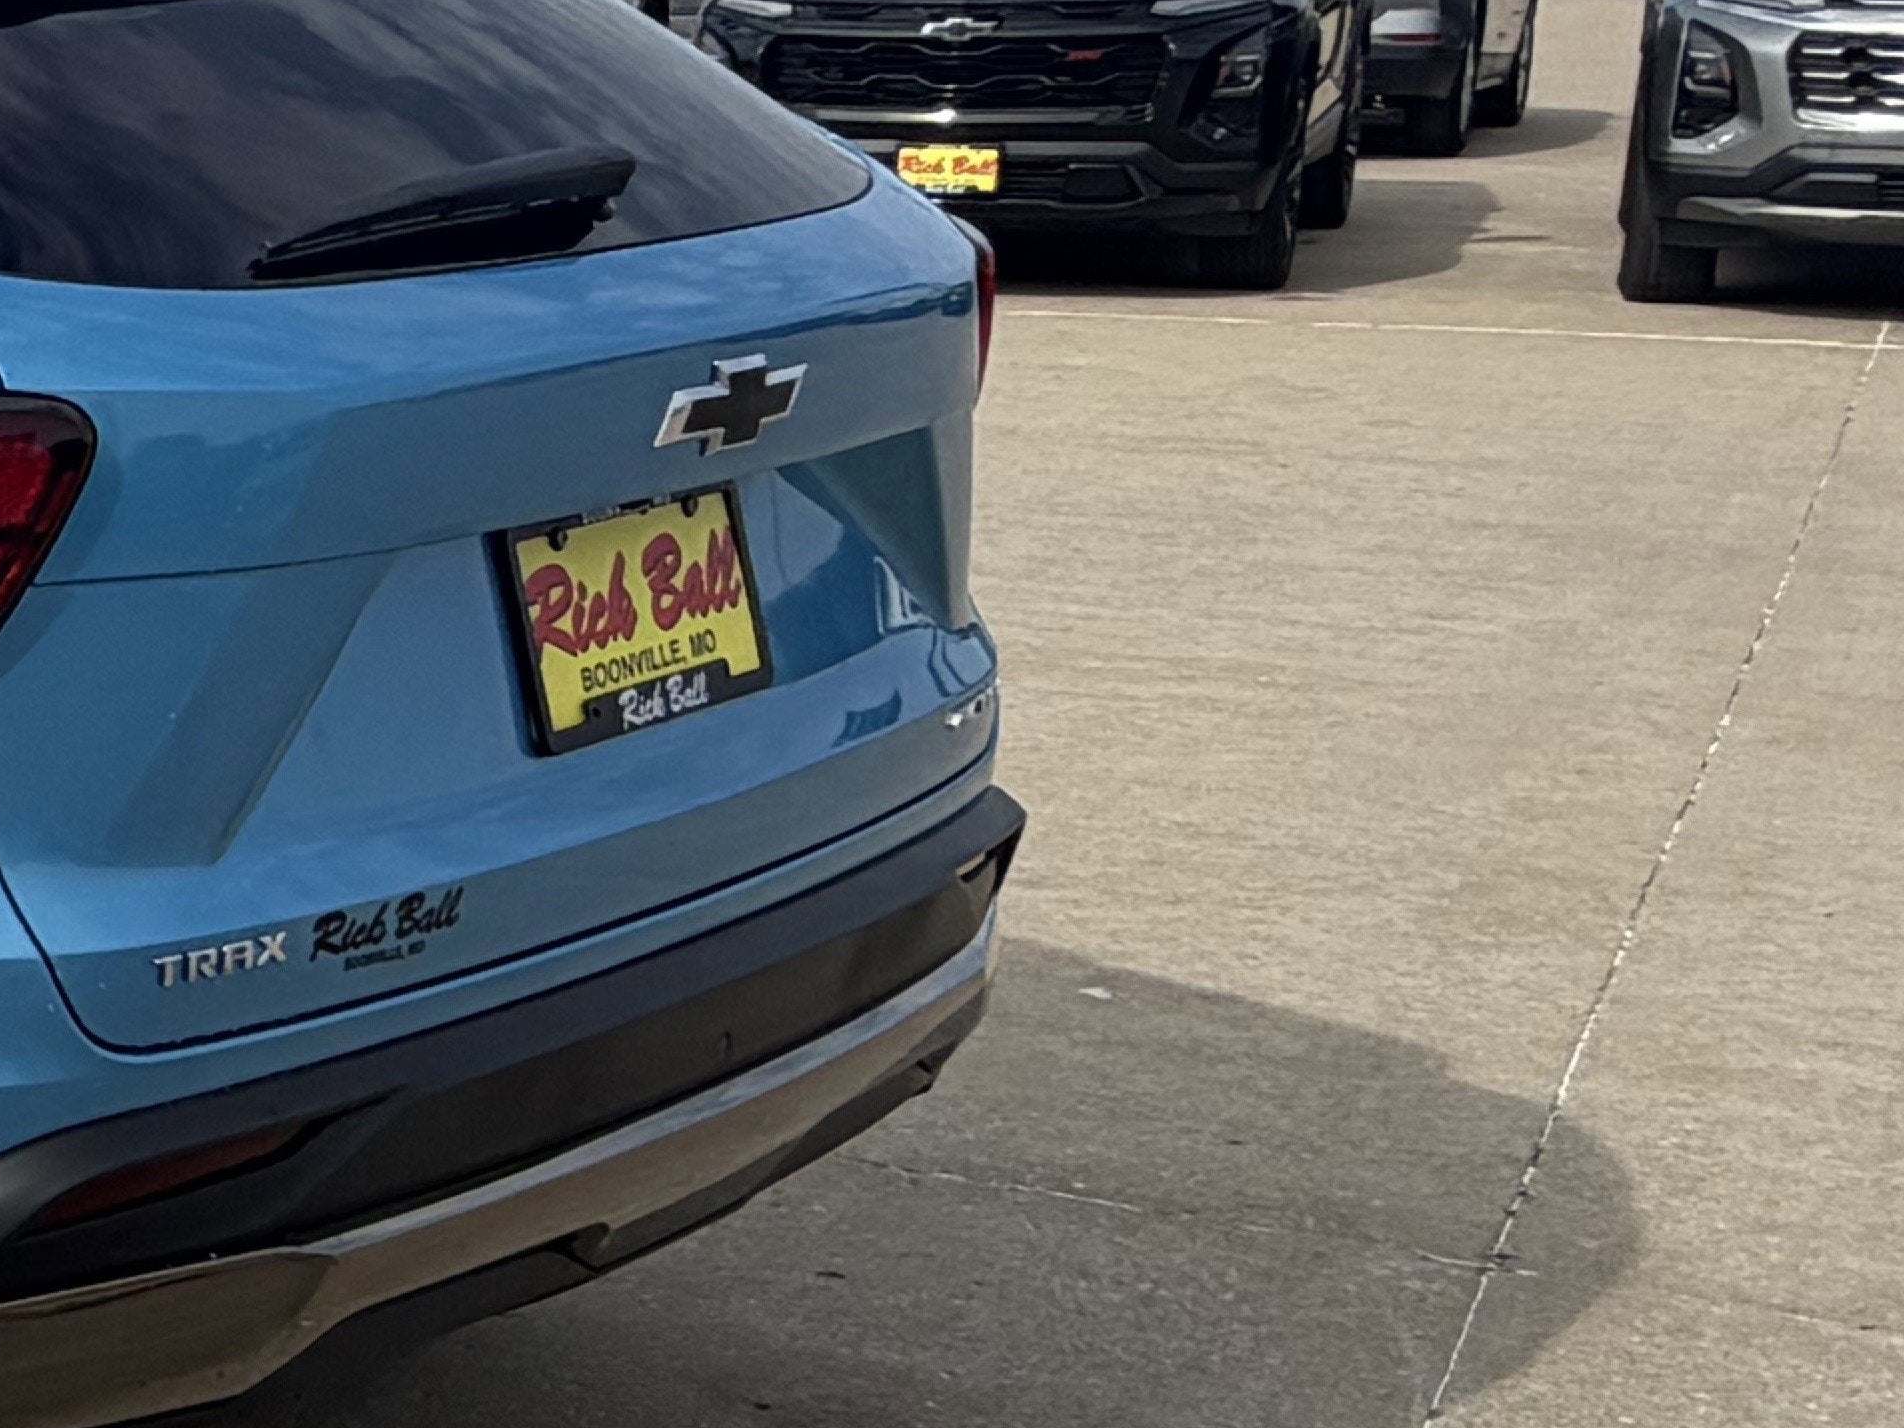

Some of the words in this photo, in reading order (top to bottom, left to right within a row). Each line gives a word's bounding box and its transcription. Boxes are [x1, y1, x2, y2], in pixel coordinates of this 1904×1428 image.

[524, 550, 638, 658] Rick
[641, 526, 741, 631] Ball
[580, 639, 688, 693] BOONVILLE,
[688, 628, 717, 659] MO
[618, 682, 667, 730] Rick
[665, 672, 709, 713] Ball
[308, 903, 391, 962] Rick
[394, 885, 465, 940] Ball
[153, 930, 288, 988] TRAX
